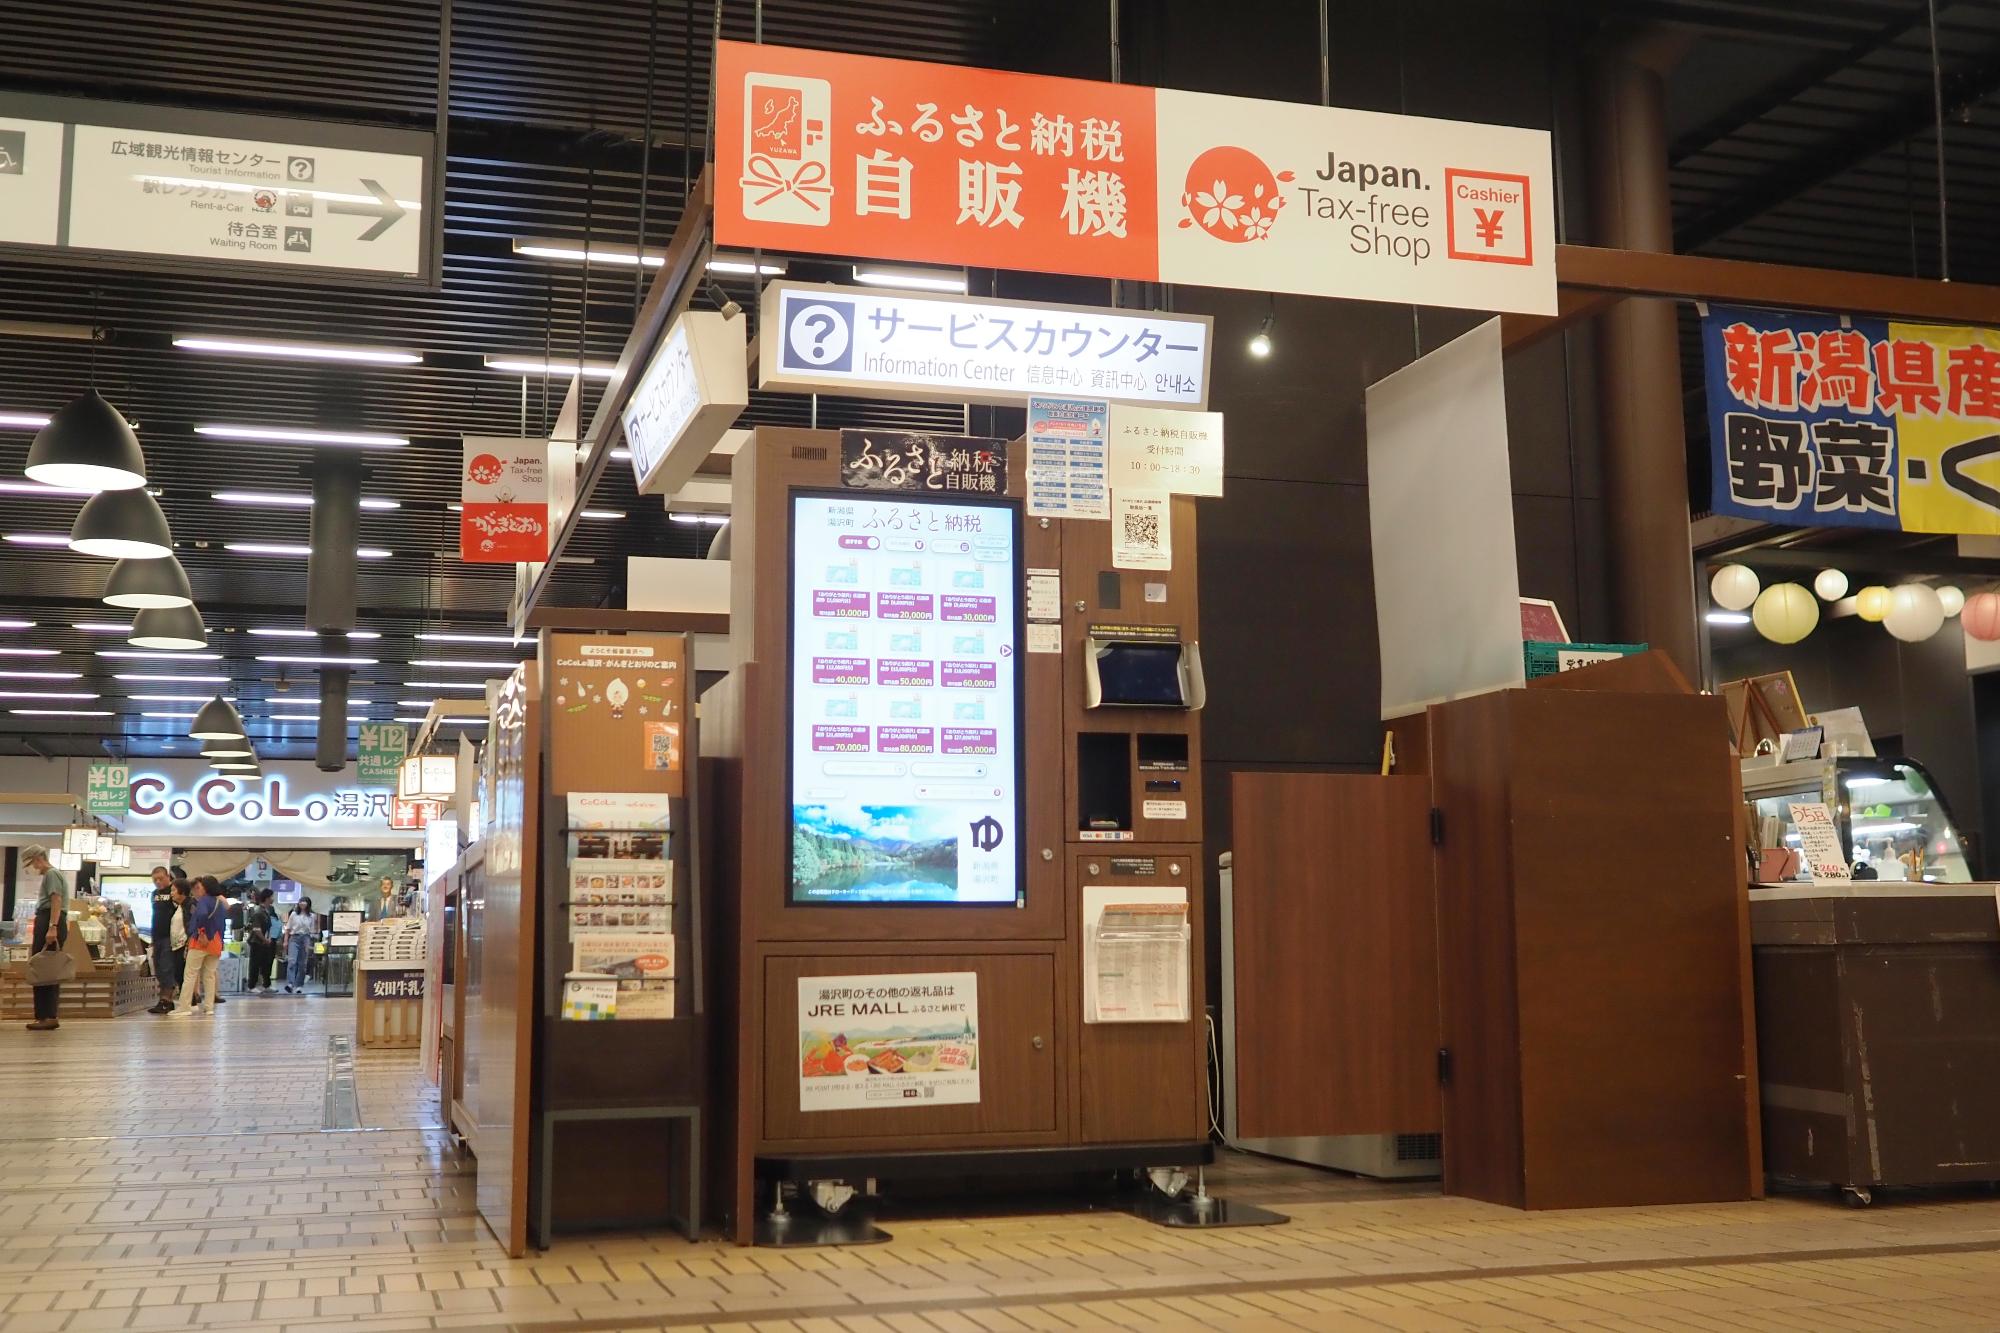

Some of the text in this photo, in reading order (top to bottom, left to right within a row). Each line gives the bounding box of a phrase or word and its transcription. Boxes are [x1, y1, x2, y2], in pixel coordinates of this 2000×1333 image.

[855, 96, 1125, 163] ふるさと納税
[111, 141, 281, 167] 広域観光情報センター
[769, 146, 798, 155] YUZAWA
[189, 164, 281, 180] Tourist Information
[1316, 151, 1431, 191] Japan.
[855, 148, 1128, 239] 自販機
[1456, 183, 1520, 205] Cashier
[190, 200, 244, 213] Rent-a-Car
[1298, 187, 1430, 228] Tax-free
[227, 221, 278, 239] 待合室
[210, 237, 278, 250] Waiting Room
[1350, 224, 1431, 266] Shop
[867, 306, 1199, 364] サービスカウンター
[863, 354, 1197, 395] Information Center 信息中心 資訊中心 안내소
[1722, 322, 2000, 421] 新潟県産
[513, 456, 543, 465] Japan.
[1146, 445, 1185, 457] 受付時間
[510, 466, 543, 475] Tax-free
[521, 475, 543, 483] Shop
[946, 473, 996, 492] 自販機
[862, 507, 983, 534] ふるさと納税
[383, 728, 403, 748] 12
[88, 791, 128, 800] 共通レジ
[332, 793, 390, 817] 湯沢
[818, 985, 956, 1001] 湯沢町のその他の返礼品は
[807, 1002, 966, 1017] JRE MALL ふるさと納税で
